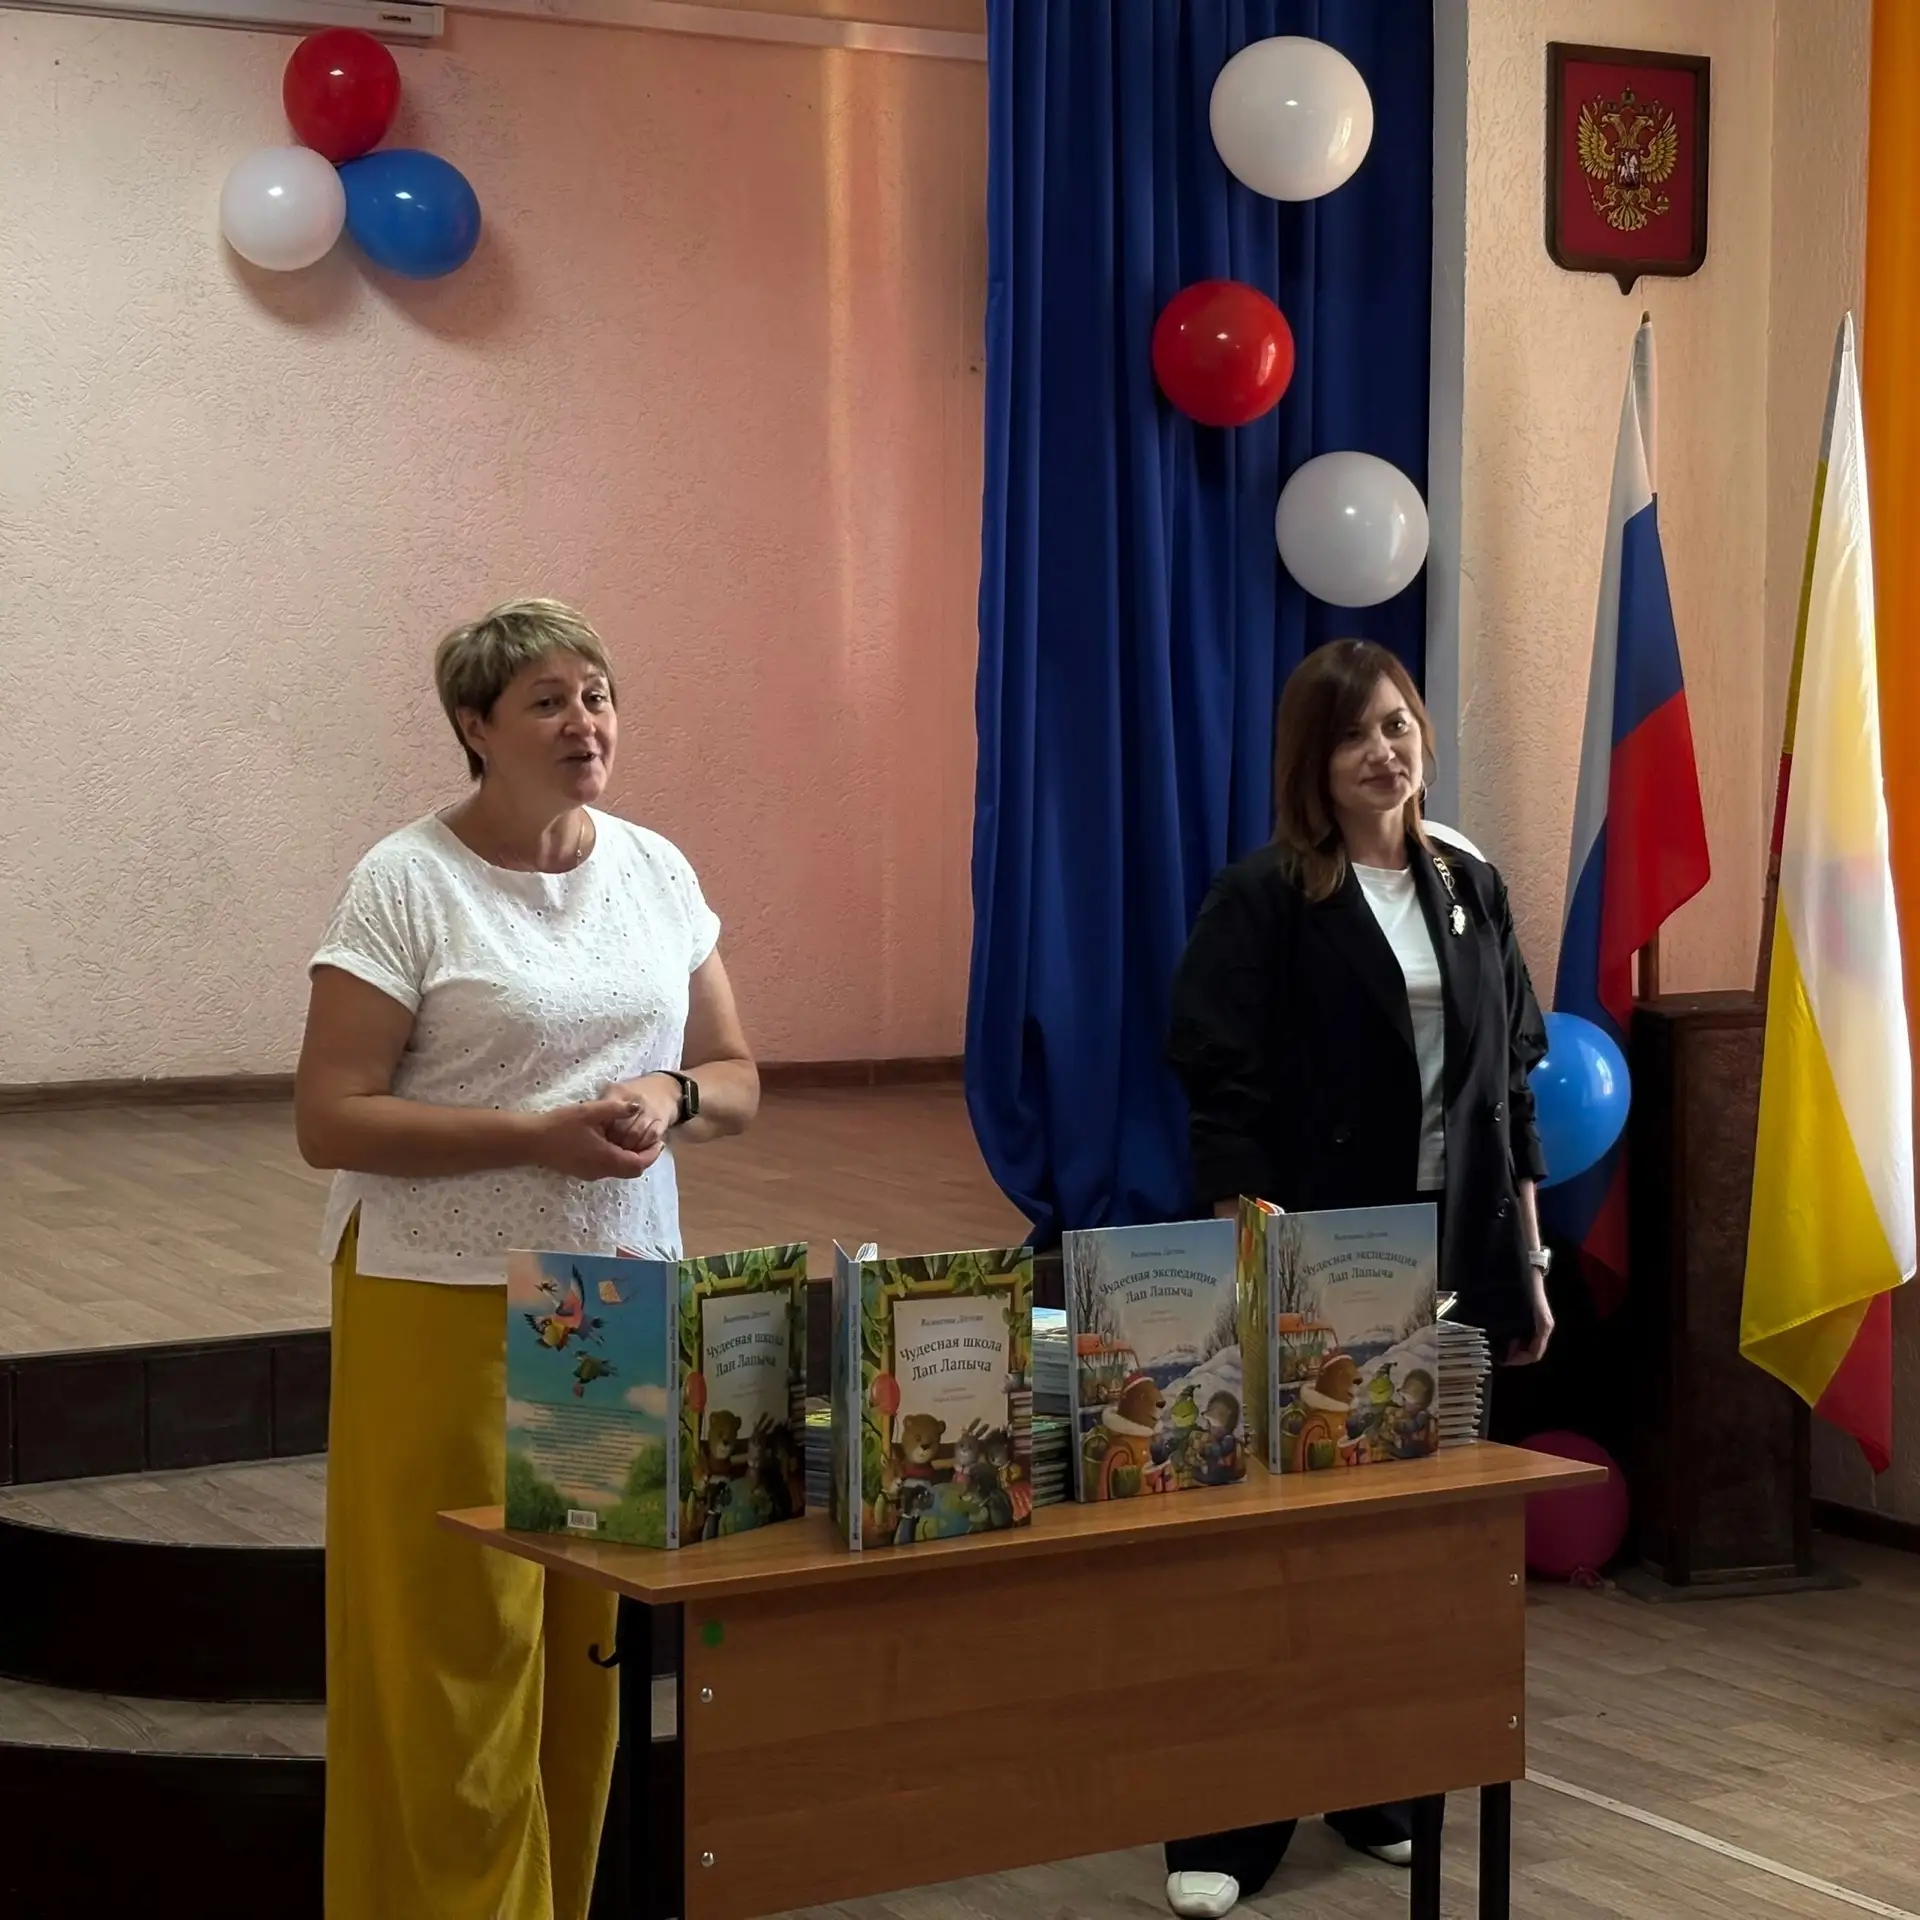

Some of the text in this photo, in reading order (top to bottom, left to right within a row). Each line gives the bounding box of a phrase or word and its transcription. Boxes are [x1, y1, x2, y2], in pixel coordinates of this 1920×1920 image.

[1302, 1250, 1419, 1276] Чудесная экспедиция
[1099, 1267, 1218, 1295] Чудесная экспедиция
[1327, 1267, 1394, 1285] Лап Лапыча
[1125, 1285, 1194, 1304] Лап Лапыча
[706, 1332, 785, 1359] Чудесная школа
[899, 1336, 1003, 1362] Чудесная школа
[716, 1353, 777, 1378] Лап Лапыча
[912, 1358, 992, 1381] Лап Лапыча
